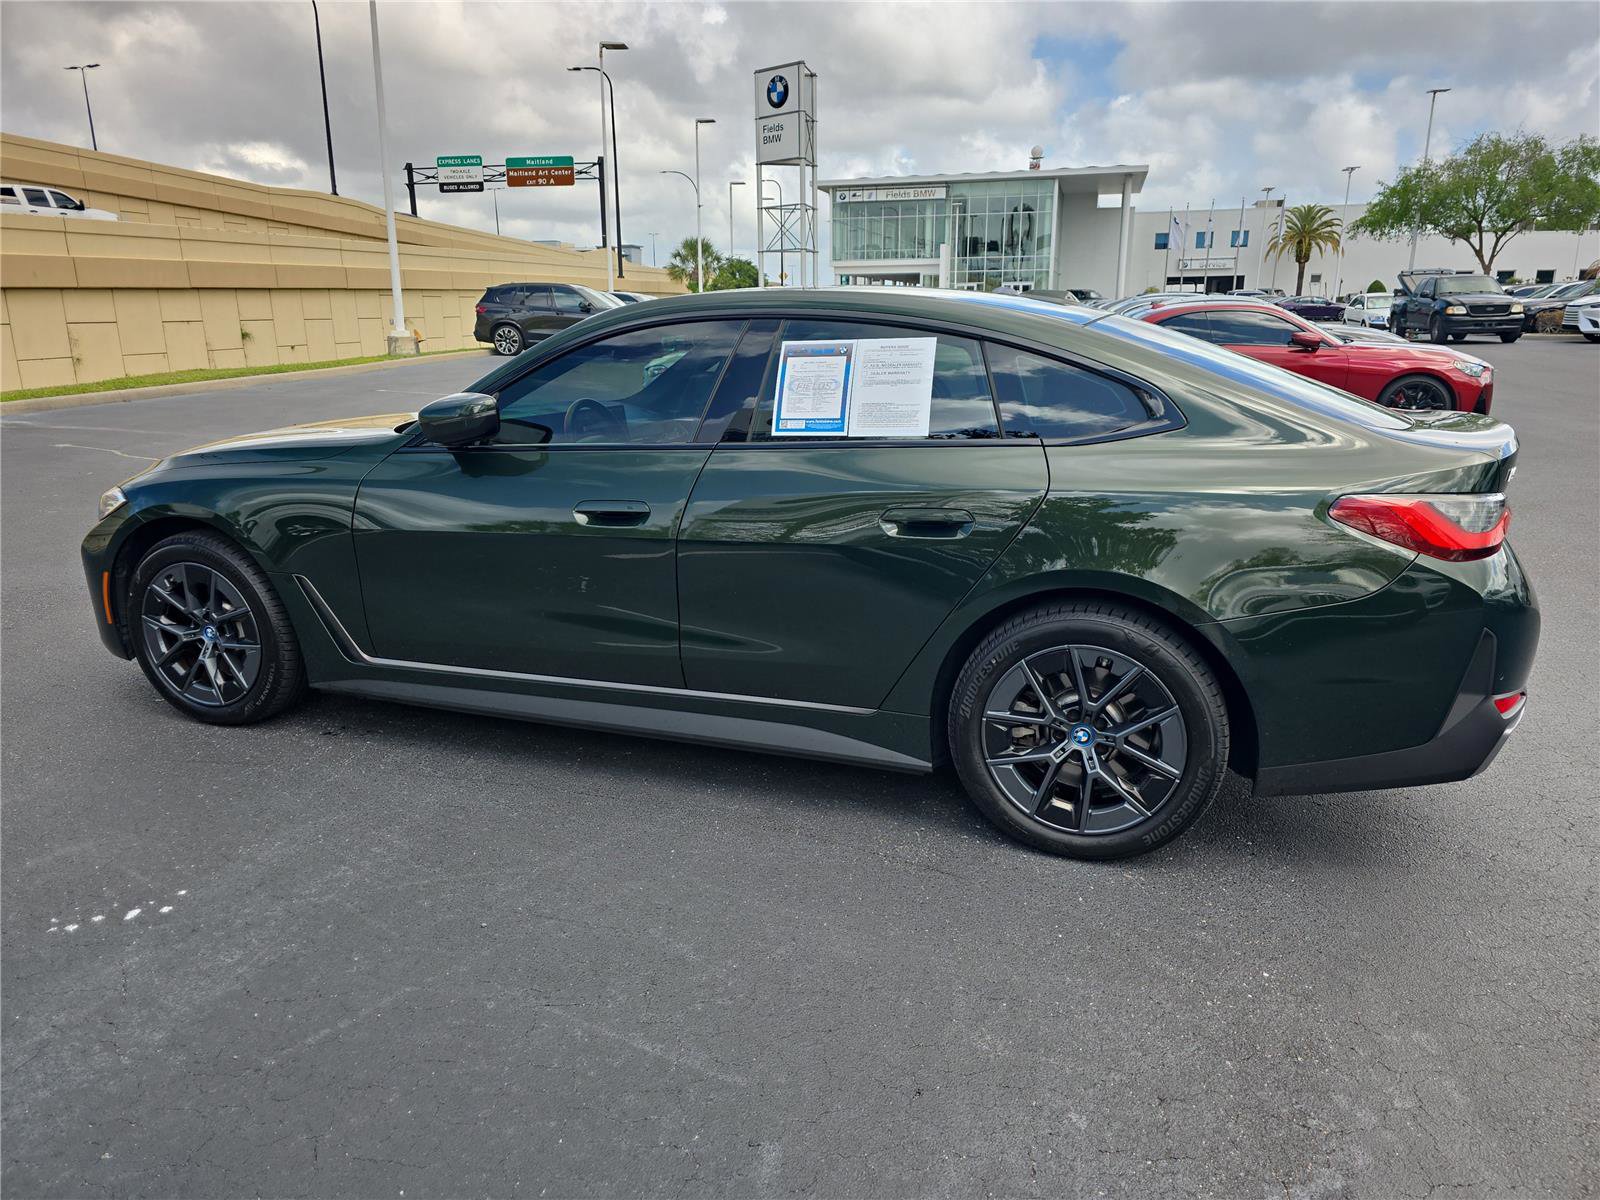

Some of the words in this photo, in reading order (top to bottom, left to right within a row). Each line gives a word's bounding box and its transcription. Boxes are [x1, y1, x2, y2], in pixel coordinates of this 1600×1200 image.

[763, 123, 784, 133] Fields
[763, 134, 782, 145] BMW
[885, 190, 912, 198] Fields
[913, 189, 937, 198] BMW
[1141, 766, 1212, 847] BRIDGESTONE
